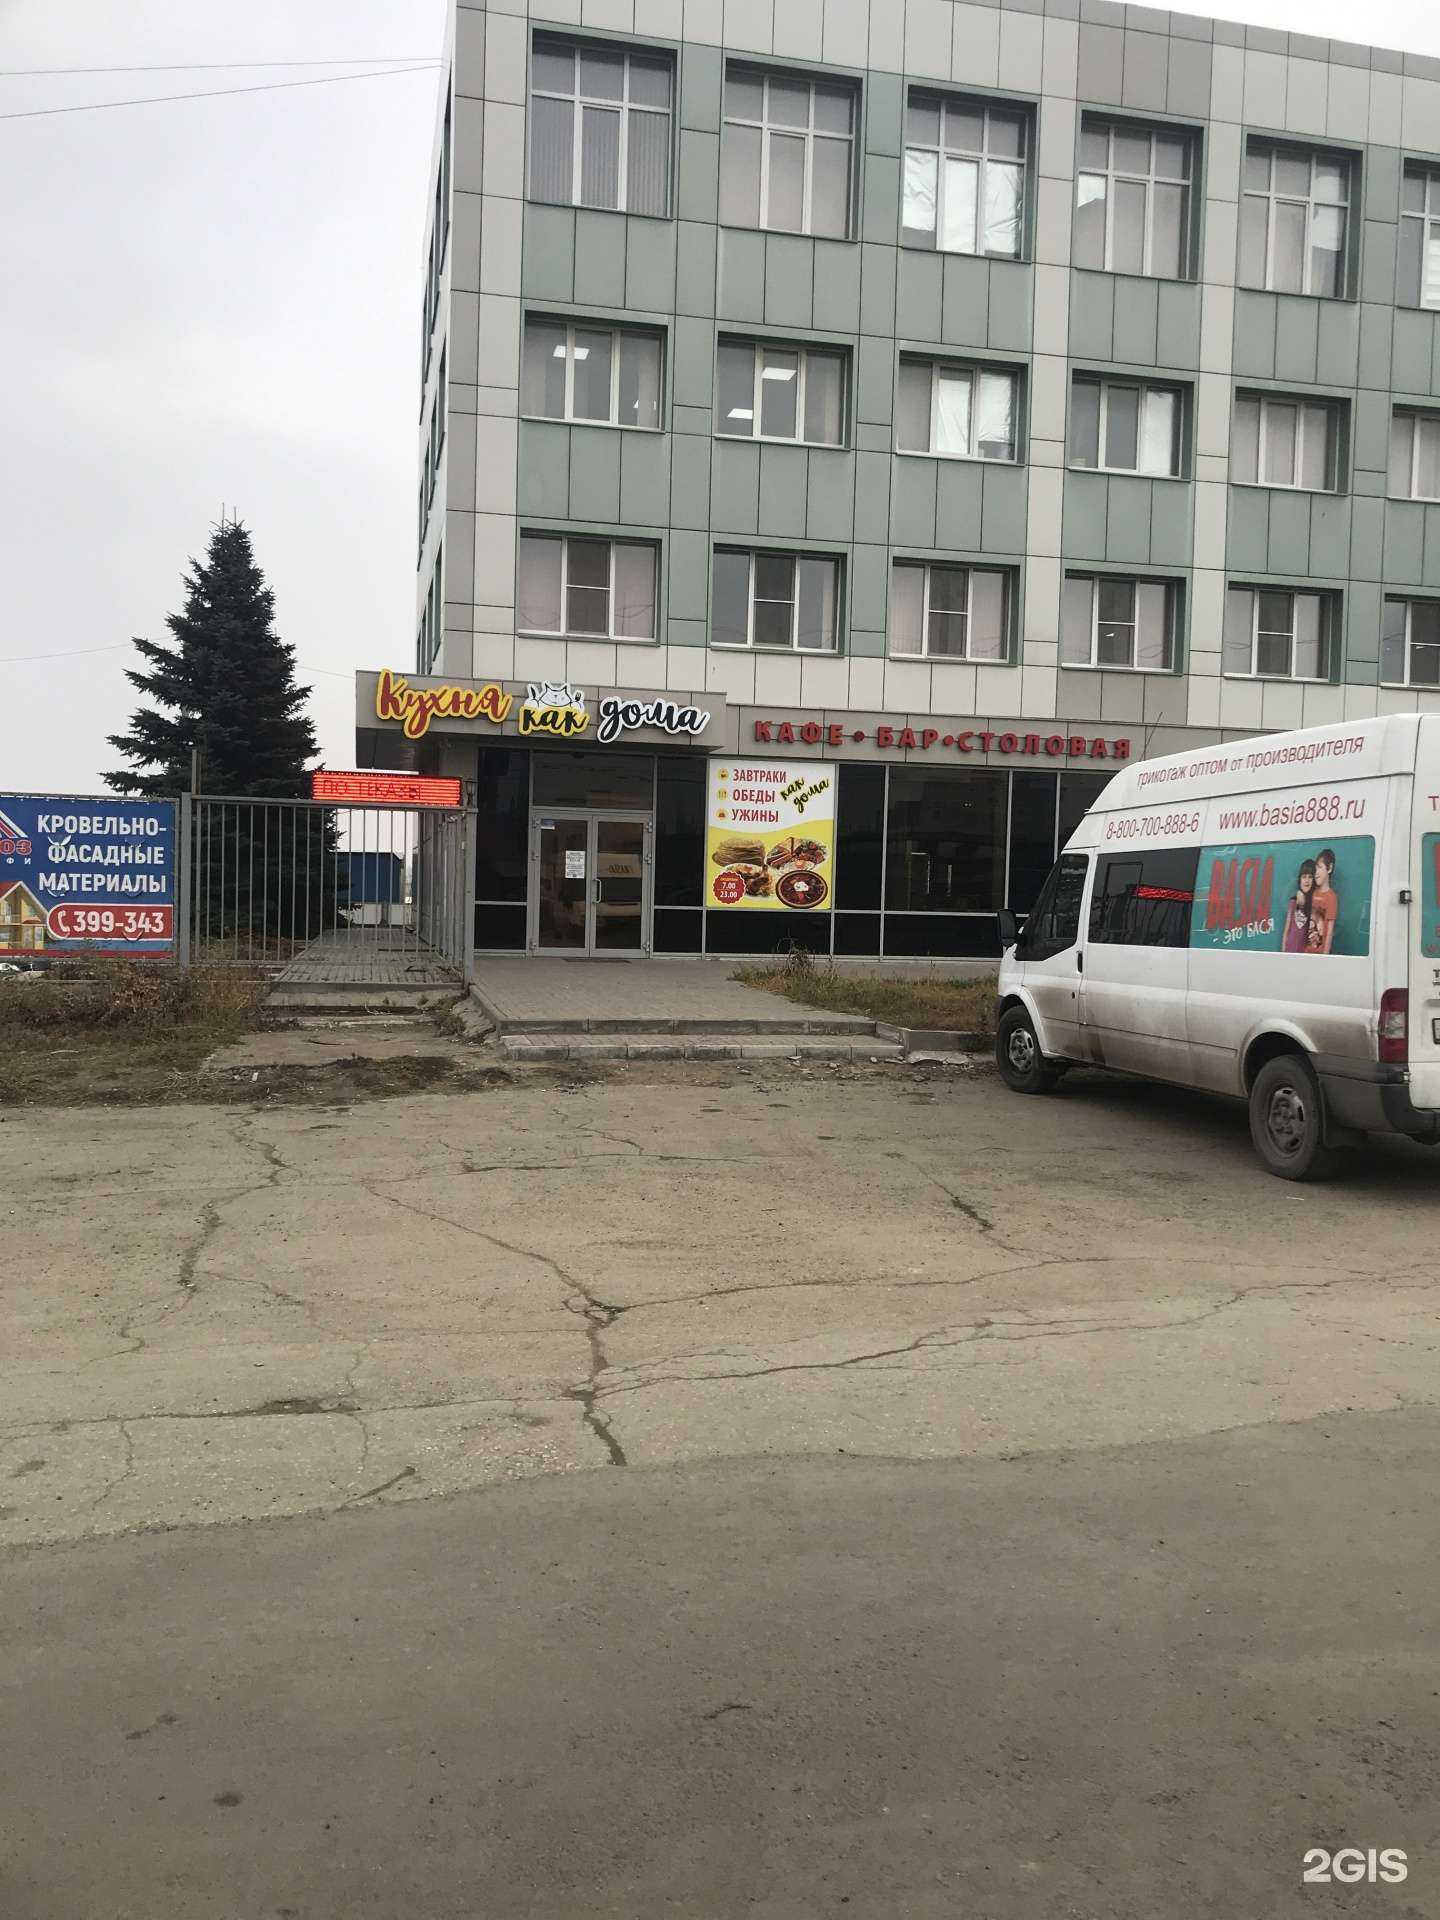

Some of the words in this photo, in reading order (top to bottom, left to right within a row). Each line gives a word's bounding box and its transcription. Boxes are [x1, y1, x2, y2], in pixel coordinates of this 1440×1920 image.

[378, 669, 511, 738] Кухня
[520, 707, 588, 736] как
[598, 697, 709, 742] дома
[755, 720, 843, 746] КАФЕ
[878, 726, 939, 750] БАР
[958, 731, 1131, 759] СТОЛОВАЯ
[1137, 764, 1188, 789] трикотаж
[1189, 758, 1228, 779] оптом
[1230, 758, 1244, 772] от
[1246, 736, 1365, 773] производителя
[733, 768, 787, 784] ЗАВТРАКИ
[732, 789, 776, 805] ОБЕДЫ
[780, 776, 805, 801] как
[731, 808, 780, 823] УЖИНЫ
[1219, 795, 1366, 831] www.basia888.ru
[38, 814, 167, 836] КРОВЕЛЬНО-
[1106, 812, 1200, 840] 8-800-700-888-6
[48, 843, 165, 866] ФАСАДНЫЕ
[38, 872, 166, 893] МАТЕРИАЛЫ
[73, 911, 164, 933] 399-343
